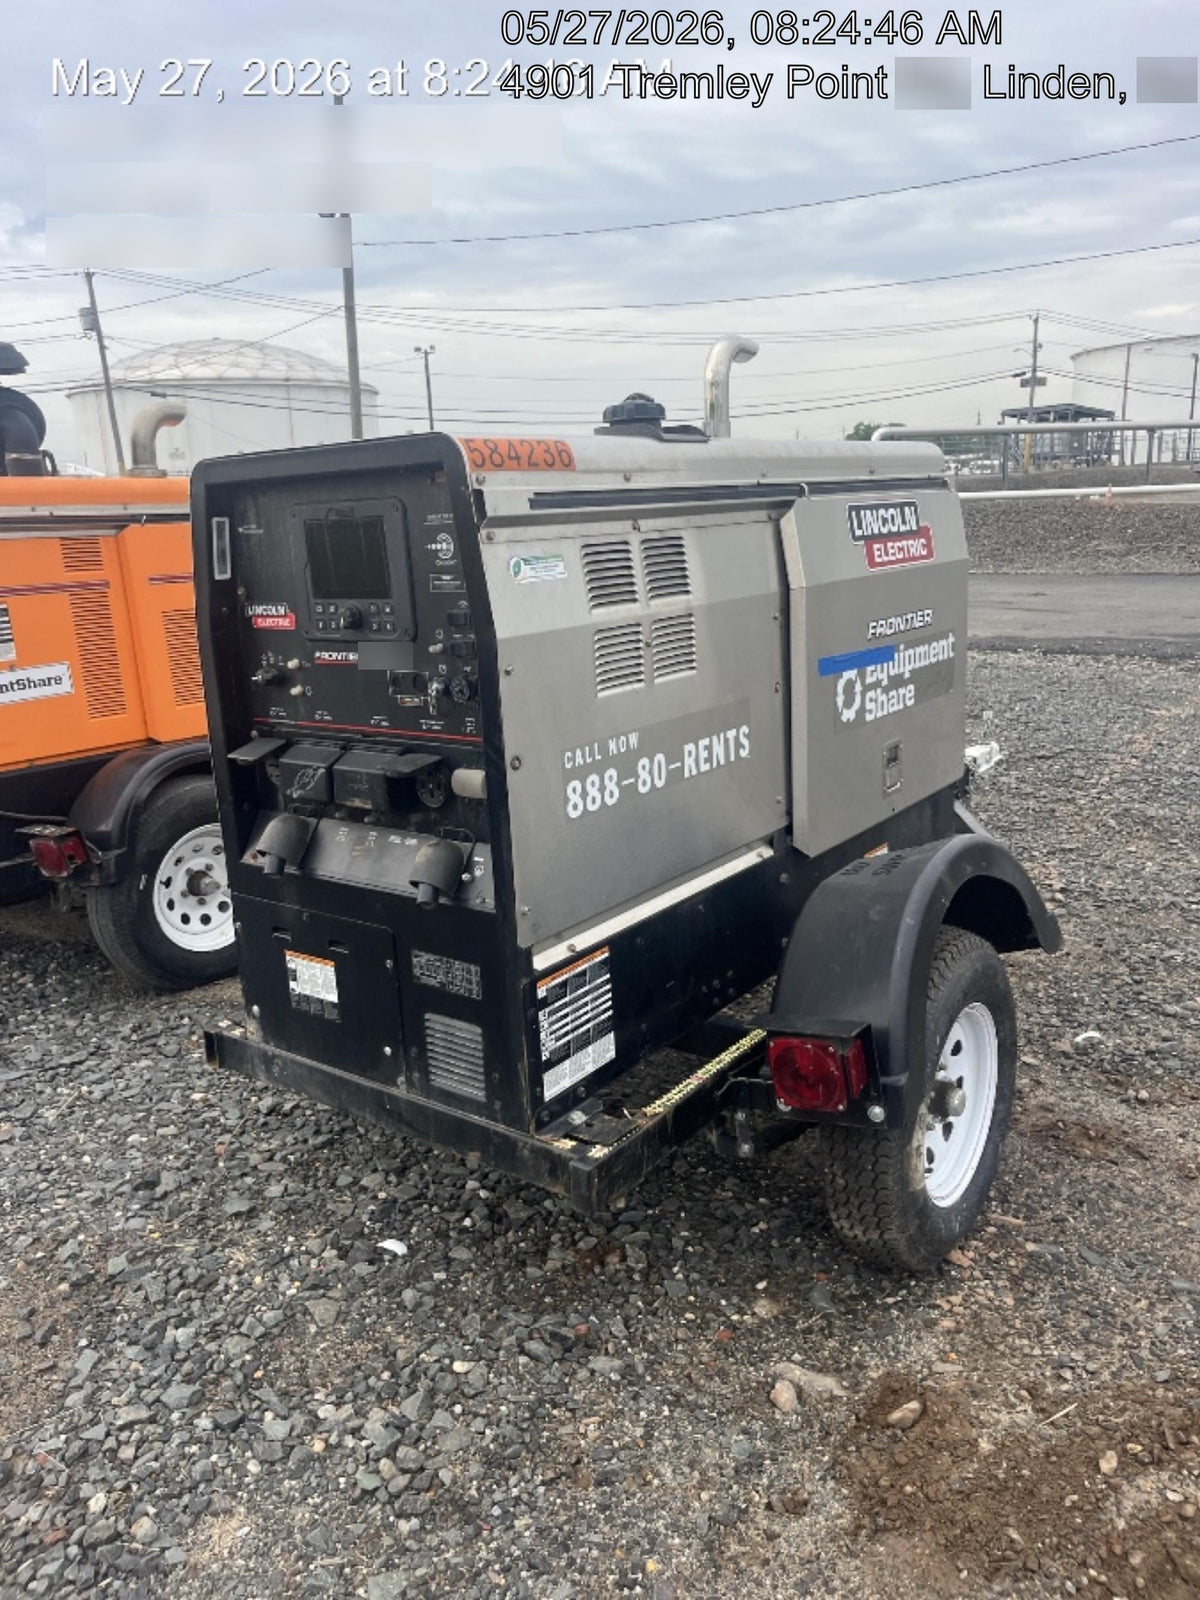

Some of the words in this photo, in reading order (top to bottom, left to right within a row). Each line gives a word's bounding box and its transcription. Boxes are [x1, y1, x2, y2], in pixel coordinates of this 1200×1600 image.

[464, 438, 572, 468] 584236
[851, 506, 918, 536] LINCOLN
[872, 538, 928, 563] ELECTRIC
[248, 604, 286, 616] LINCOLN
[867, 609, 933, 641] FRONTIER
[865, 684, 915, 722] Share
[564, 743, 602, 769] CALL
[608, 732, 639, 756] NOW
[566, 725, 750, 819] 888-80-RENTS
